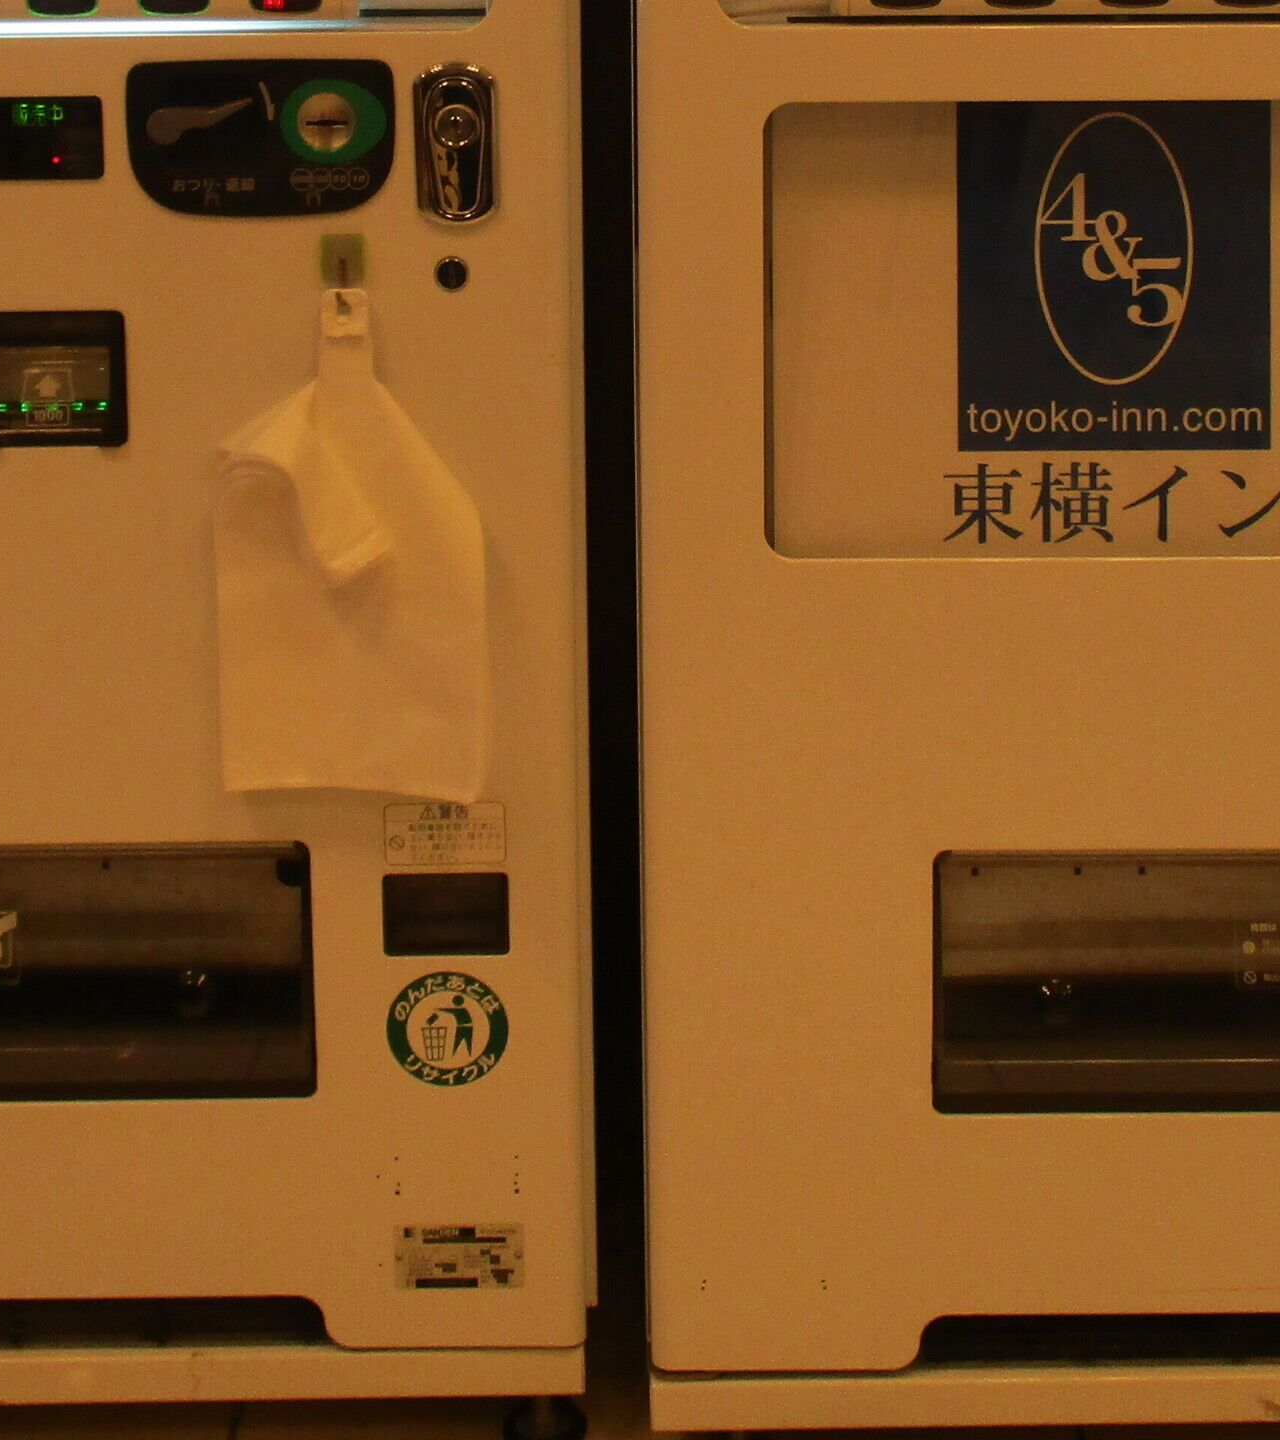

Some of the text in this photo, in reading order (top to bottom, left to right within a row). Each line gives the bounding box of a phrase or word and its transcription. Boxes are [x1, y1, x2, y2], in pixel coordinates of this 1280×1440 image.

[1039, 172, 1187, 328] 4&5
[966, 400, 1264, 442] toyoko-inn.com
[393, 973, 502, 1024] のんだあとは
[403, 1049, 498, 1086] リサイクル
